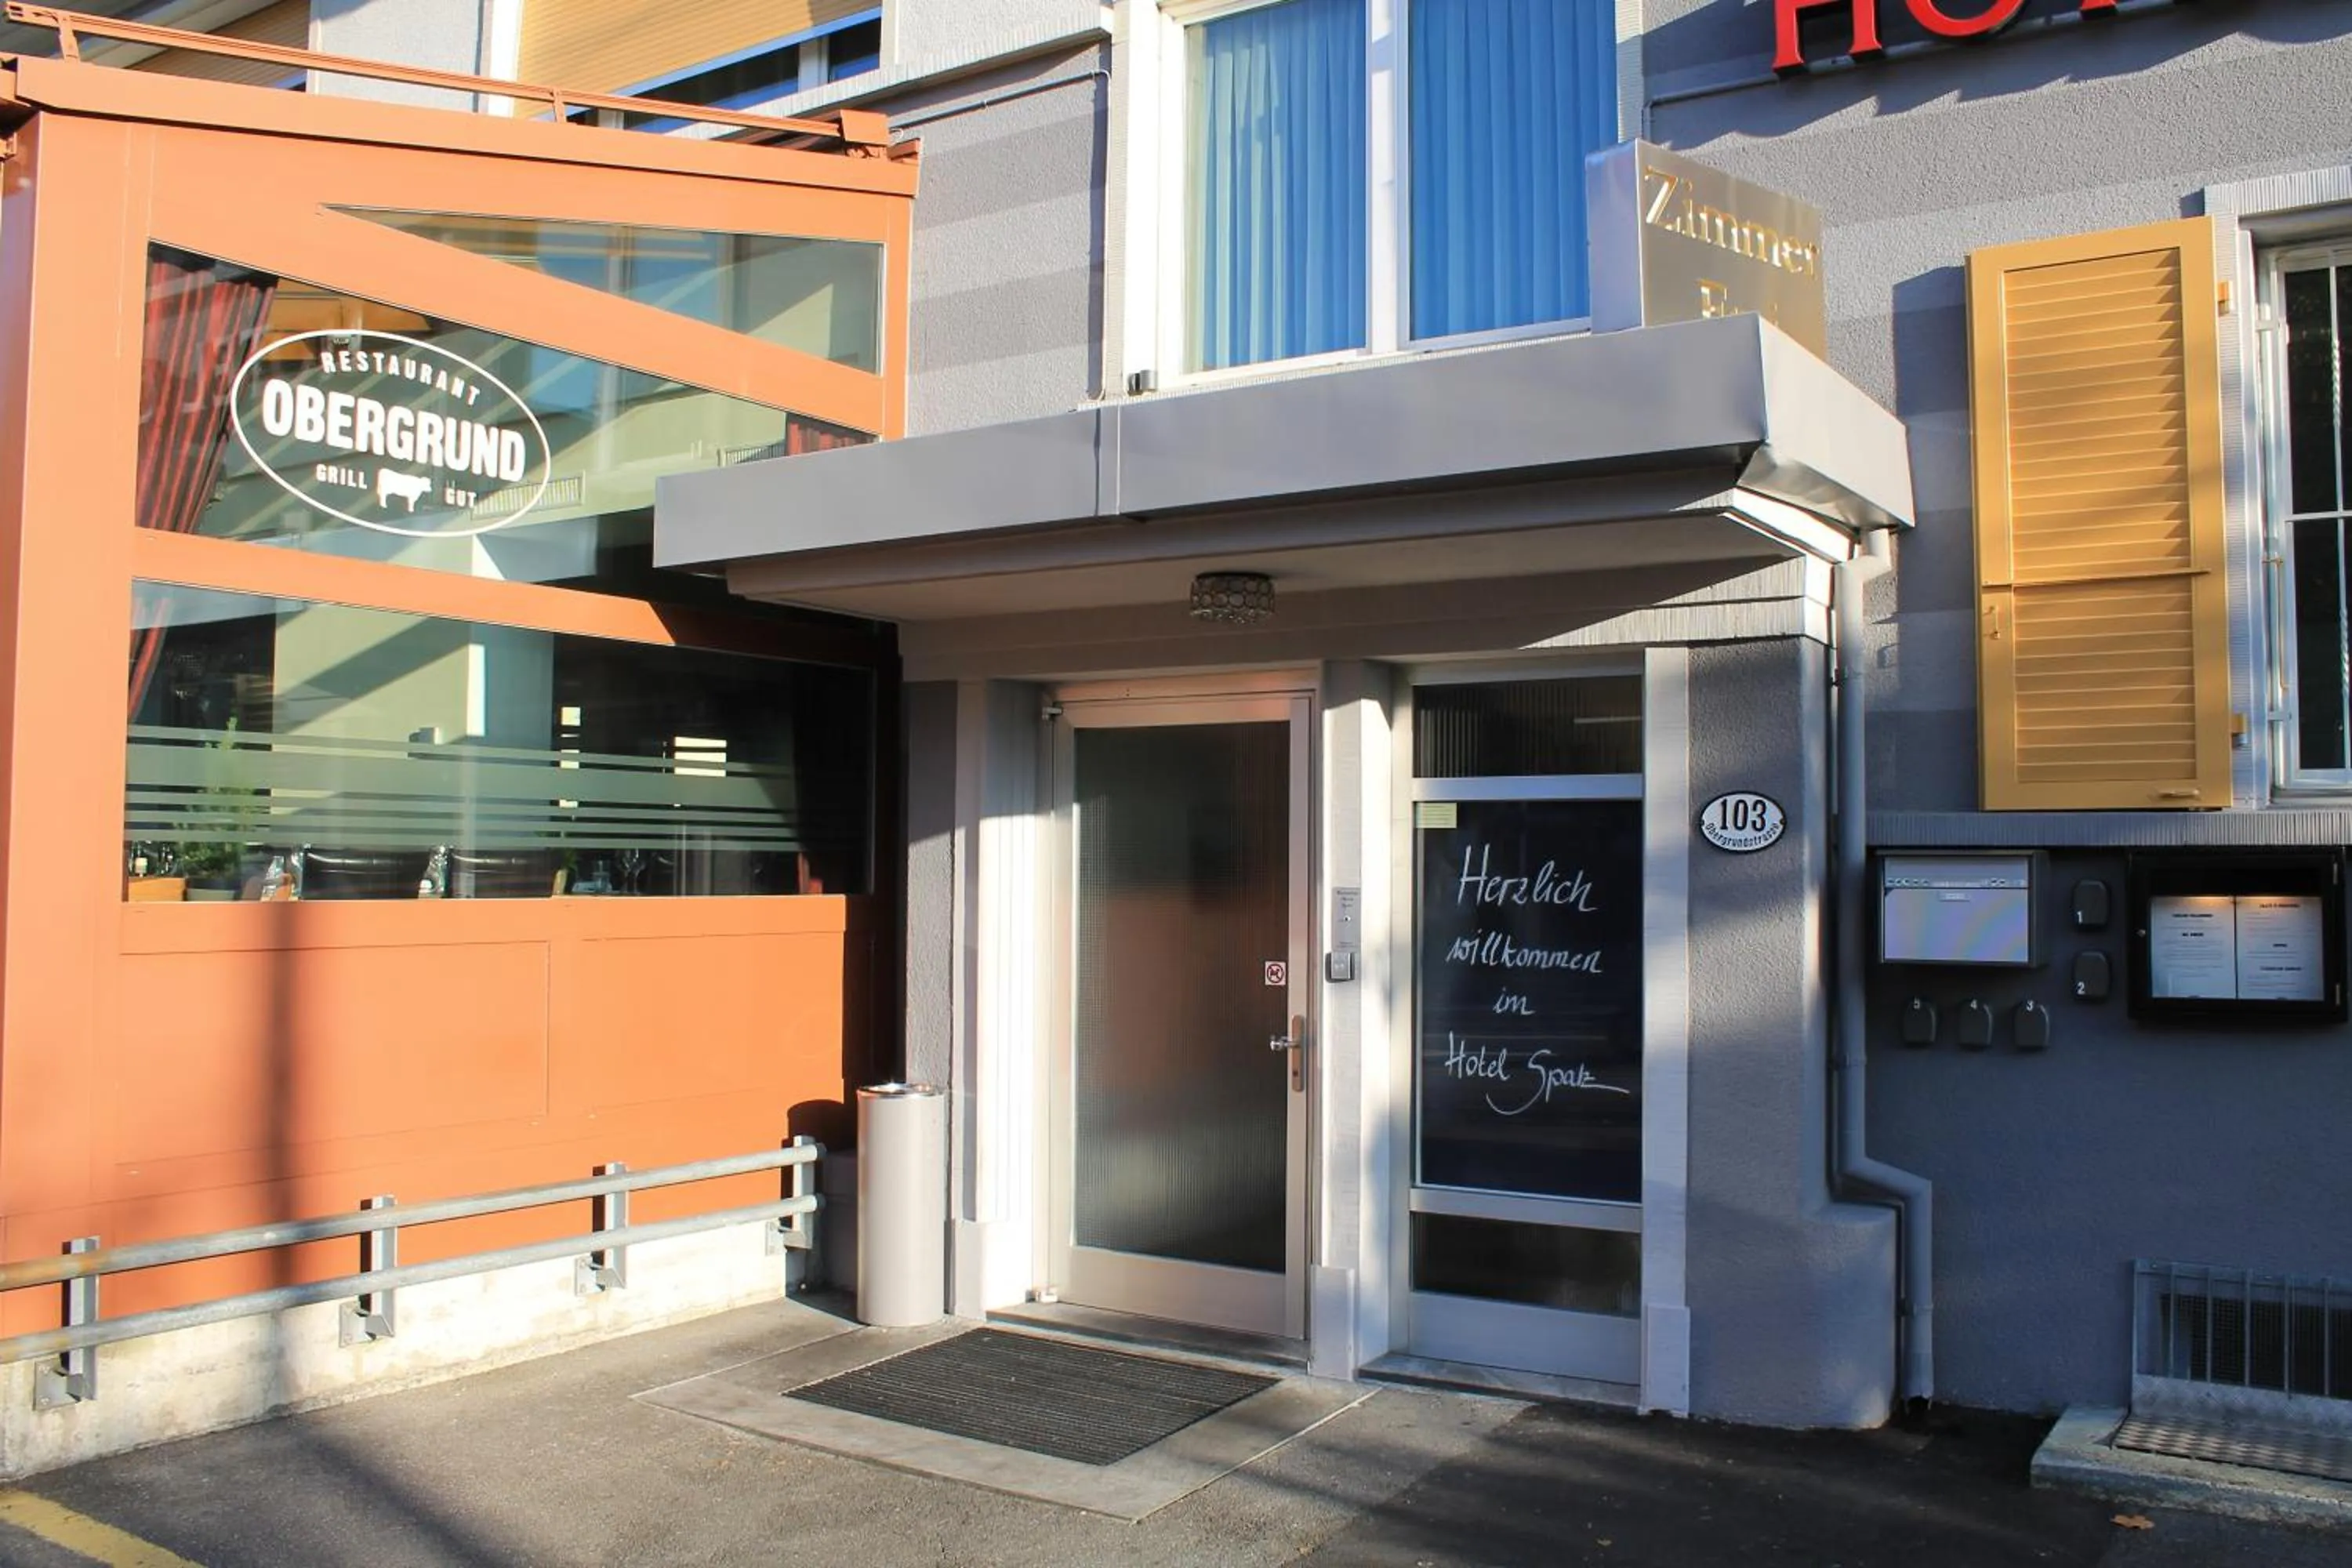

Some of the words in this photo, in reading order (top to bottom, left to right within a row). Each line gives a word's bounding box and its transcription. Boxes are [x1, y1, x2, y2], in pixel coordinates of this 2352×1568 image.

[1644, 165, 1818, 277] Zimmer
[321, 350, 481, 406] RESTAURANT
[261, 378, 526, 483] OBERGRUND
[316, 463, 368, 490] GRILL
[444, 486, 477, 508] GUT
[1720, 798, 1766, 832] 103
[1457, 843, 1599, 912] Herzlich
[2076, 910, 2083, 924] 1
[1446, 928, 1602, 974] willkommen
[1493, 986, 1535, 1016] im
[1970, 998, 1978, 1010] 4
[2026, 999, 2034, 1011] 3
[2077, 981, 2085, 995] 2
[1445, 1030, 1510, 1081] Hotel
[1486, 1049, 1631, 1116] Spatz
